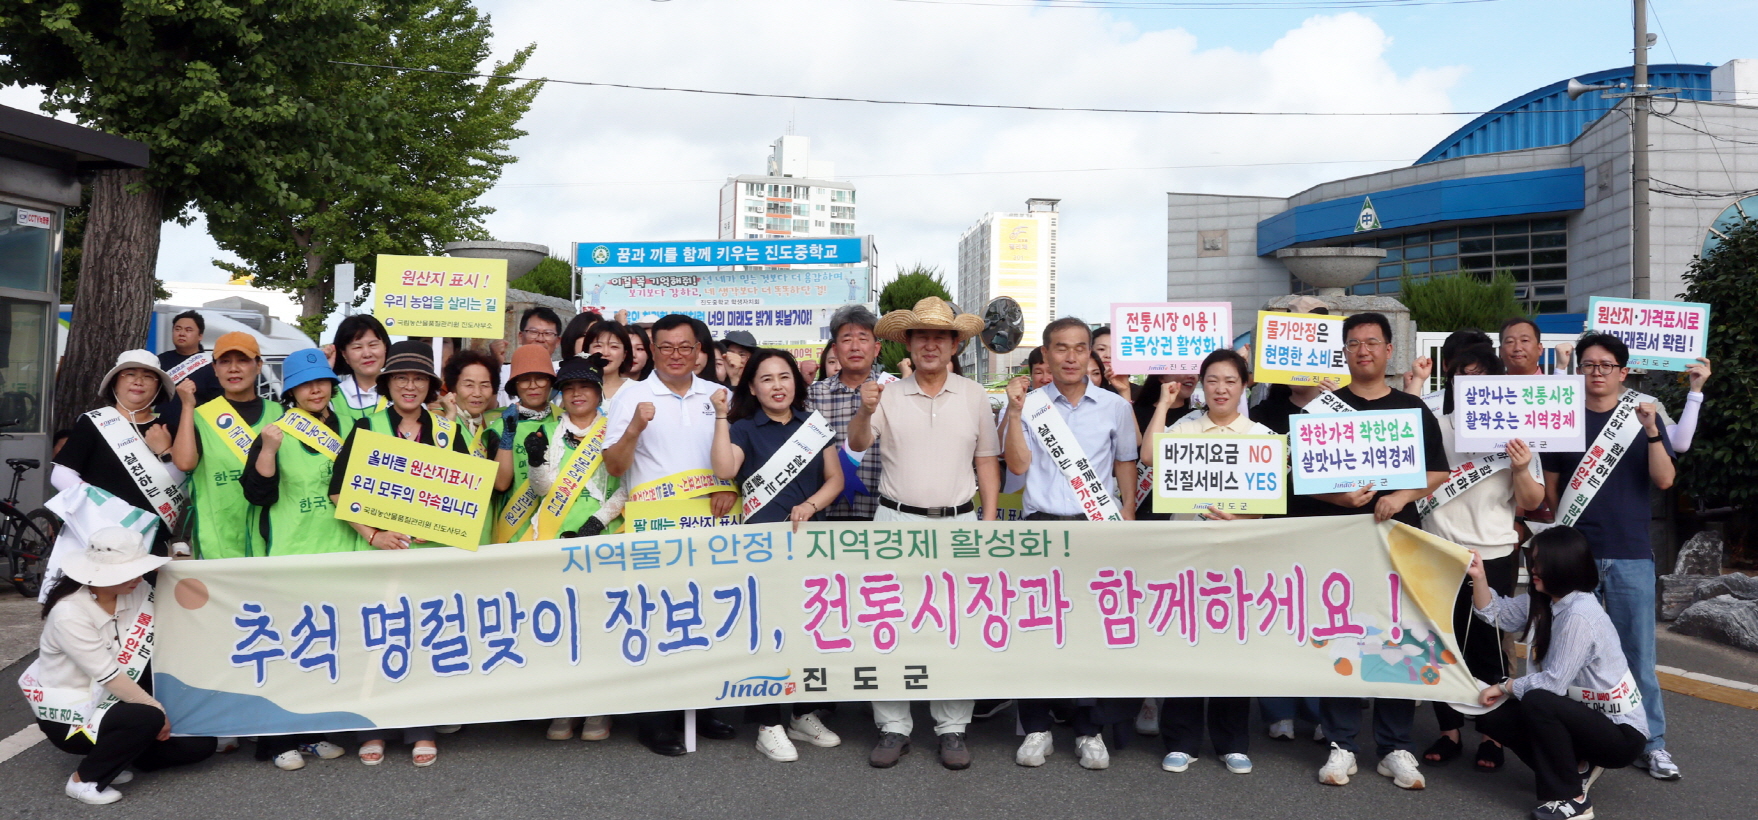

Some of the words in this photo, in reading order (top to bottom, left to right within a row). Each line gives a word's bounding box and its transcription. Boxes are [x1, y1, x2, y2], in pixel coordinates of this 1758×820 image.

[616, 247, 645, 263] 꿈과
[649, 247, 678, 263] 끼를
[683, 246, 711, 262] 함께
[717, 246, 760, 261] 키우는
[765, 244, 838, 261] 진도중학교
[402, 270, 446, 287] 원산지
[611, 275, 632, 288] 이걸
[635, 275, 646, 288] 꼭
[649, 275, 698, 287] 기억해줘!
[703, 275, 713, 285] 넌
[740, 274, 757, 285] 믿는
[761, 273, 787, 284] 것보다
[792, 273, 801, 282] 더
[805, 272, 843, 283] 용감하며
[383, 294, 407, 309] 우리
[410, 295, 444, 310] 농업을
[447, 296, 482, 311] 살리는
[486, 298, 497, 312] 길
[629, 288, 666, 298] 보기보다
[669, 288, 702, 298] 강하고,
[704, 287, 715, 296] 네
[719, 286, 758, 297] 생각보다
[762, 286, 771, 295] 더
[775, 285, 811, 296] 똑똑하단
[815, 285, 827, 296] 걸!
[397, 319, 460, 328] 국립농산물품질관리원
[461, 321, 493, 329] 진도사무소
[708, 311, 725, 326] 너의
[727, 310, 753, 326] 미래도
[755, 310, 773, 326] 밝게
[775, 309, 812, 326] 빛날거야!
[1126, 311, 1179, 333] 전통시장
[1266, 320, 1329, 343] 물가안정은
[1602, 330, 1660, 351] 거래질서
[1120, 336, 1173, 357] 골목상권
[1265, 345, 1302, 367] 현명한
[1306, 349, 1349, 369] 소비로
[1465, 386, 1518, 406] 살맛나는
[1521, 385, 1575, 405] 전통시장
[1465, 410, 1519, 430] 활짝웃는
[1524, 410, 1575, 430] 지역경제
[1603, 403, 1635, 441] 실천하는
[228, 426, 253, 455] 국립
[284, 412, 343, 455] 국립농산물
[1300, 421, 1355, 446] 착한가격
[1359, 418, 1415, 443] 착한업소
[1037, 423, 1073, 471] 실천하는
[1164, 443, 1239, 465] 바가지요금
[1249, 445, 1272, 463] NO
[367, 450, 408, 473] 올바른
[1301, 447, 1357, 473] 살맛나는
[1362, 445, 1415, 469] 지역경제
[1570, 445, 1605, 491] 물가안정
[1586, 442, 1625, 489] 함께하는
[123, 452, 161, 498] 실천하는
[763, 454, 807, 496] 살맛나는
[1075, 457, 1111, 507] 함께하는
[1164, 469, 1239, 492] 친절서비스
[1244, 472, 1277, 491] YES
[1444, 464, 1493, 498] 함께하는
[164, 484, 184, 511] 함께
[299, 496, 331, 513] 한국
[350, 475, 376, 494] 우리
[377, 480, 415, 503] 모두의
[418, 490, 479, 519] 약속입니다
[743, 496, 762, 516] 전통
[1070, 476, 1104, 521] 물가안정
[363, 506, 432, 529] 국립농산물품질관리원
[433, 523, 468, 538] 진도사무소
[634, 518, 648, 532] 팔
[650, 518, 676, 531] 때는
[679, 516, 716, 530] 원산지
[977, 506, 1005, 521] 원지
[560, 536, 697, 573] 지역물가
[806, 529, 938, 561] 지역경제
[803, 567, 1070, 653] 전통시장과
[117, 612, 153, 665] 물가안정
[230, 602, 341, 686] 추석
[362, 585, 580, 681] 명절맞이
[604, 574, 784, 666] 장보기,
[138, 631, 155, 660] 하는
[23, 688, 44, 703] 시장
[715, 679, 783, 701] Jindo
[1582, 681, 1630, 702] 전통시장
